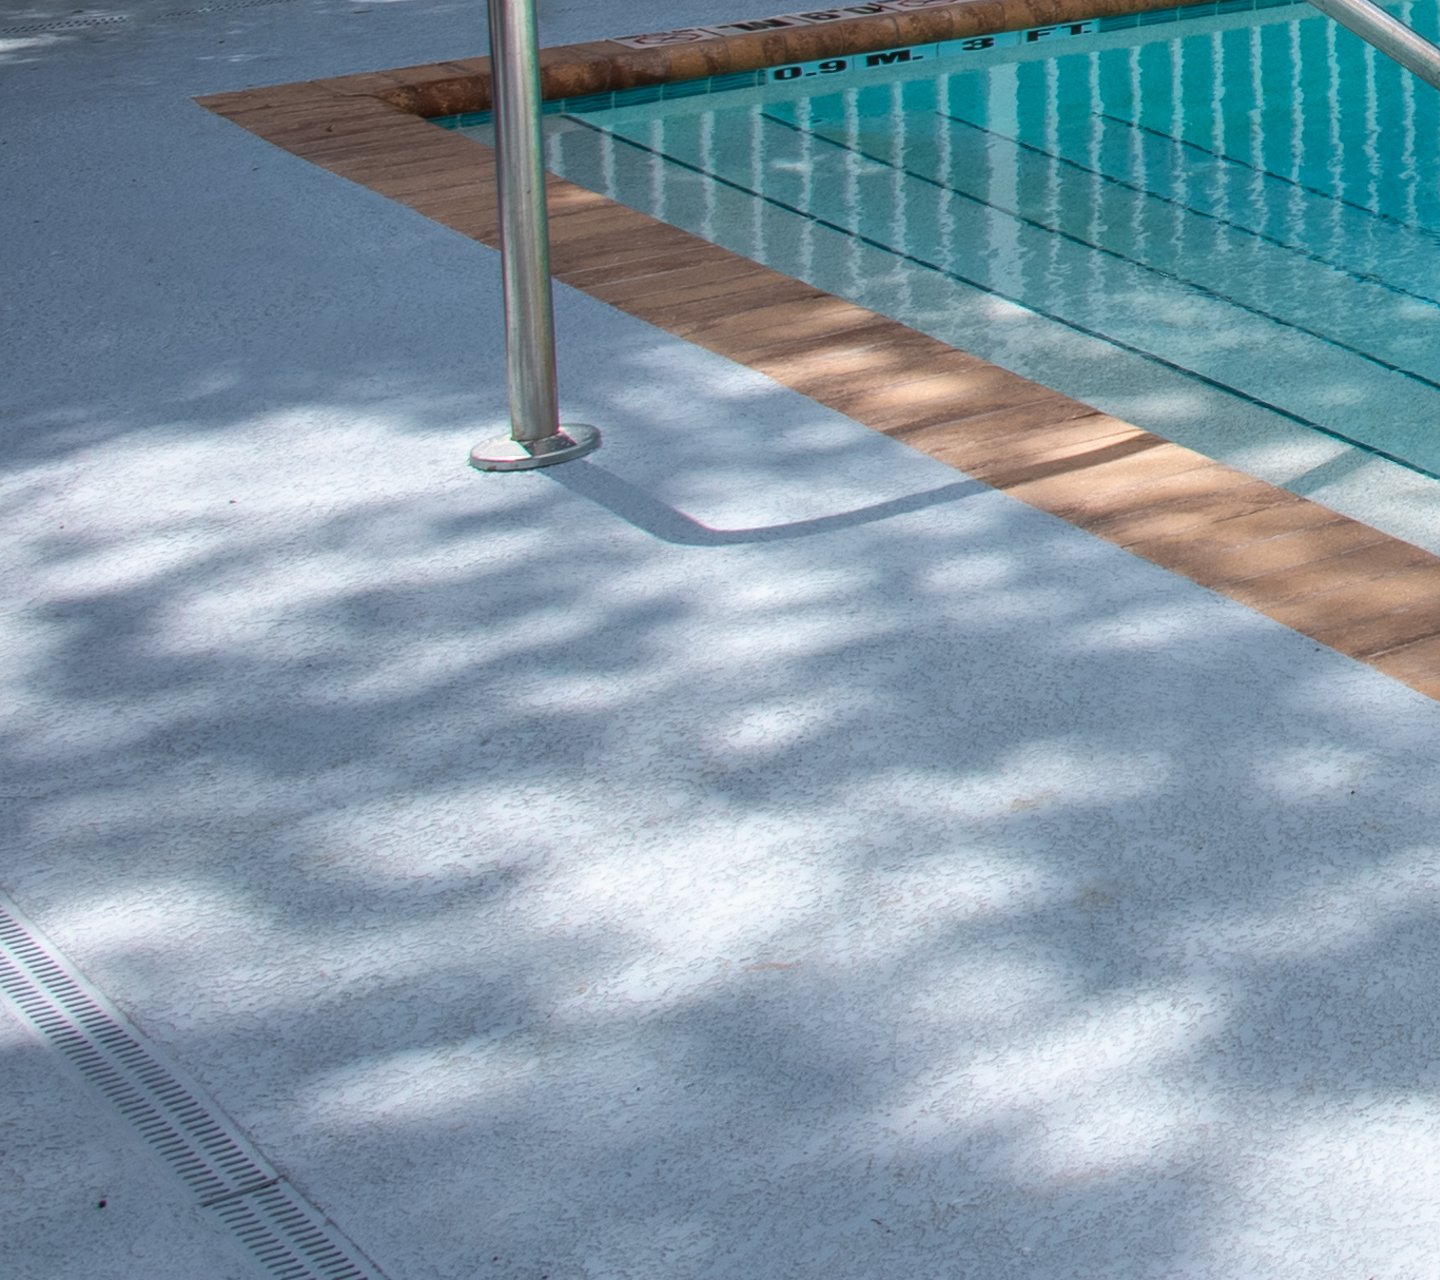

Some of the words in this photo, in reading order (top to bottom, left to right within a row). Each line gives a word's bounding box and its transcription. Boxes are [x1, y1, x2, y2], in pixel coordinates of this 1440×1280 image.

[773, 59, 847, 81] 0.9
[865, 49, 924, 68] M.
[962, 37, 994, 51] 3
